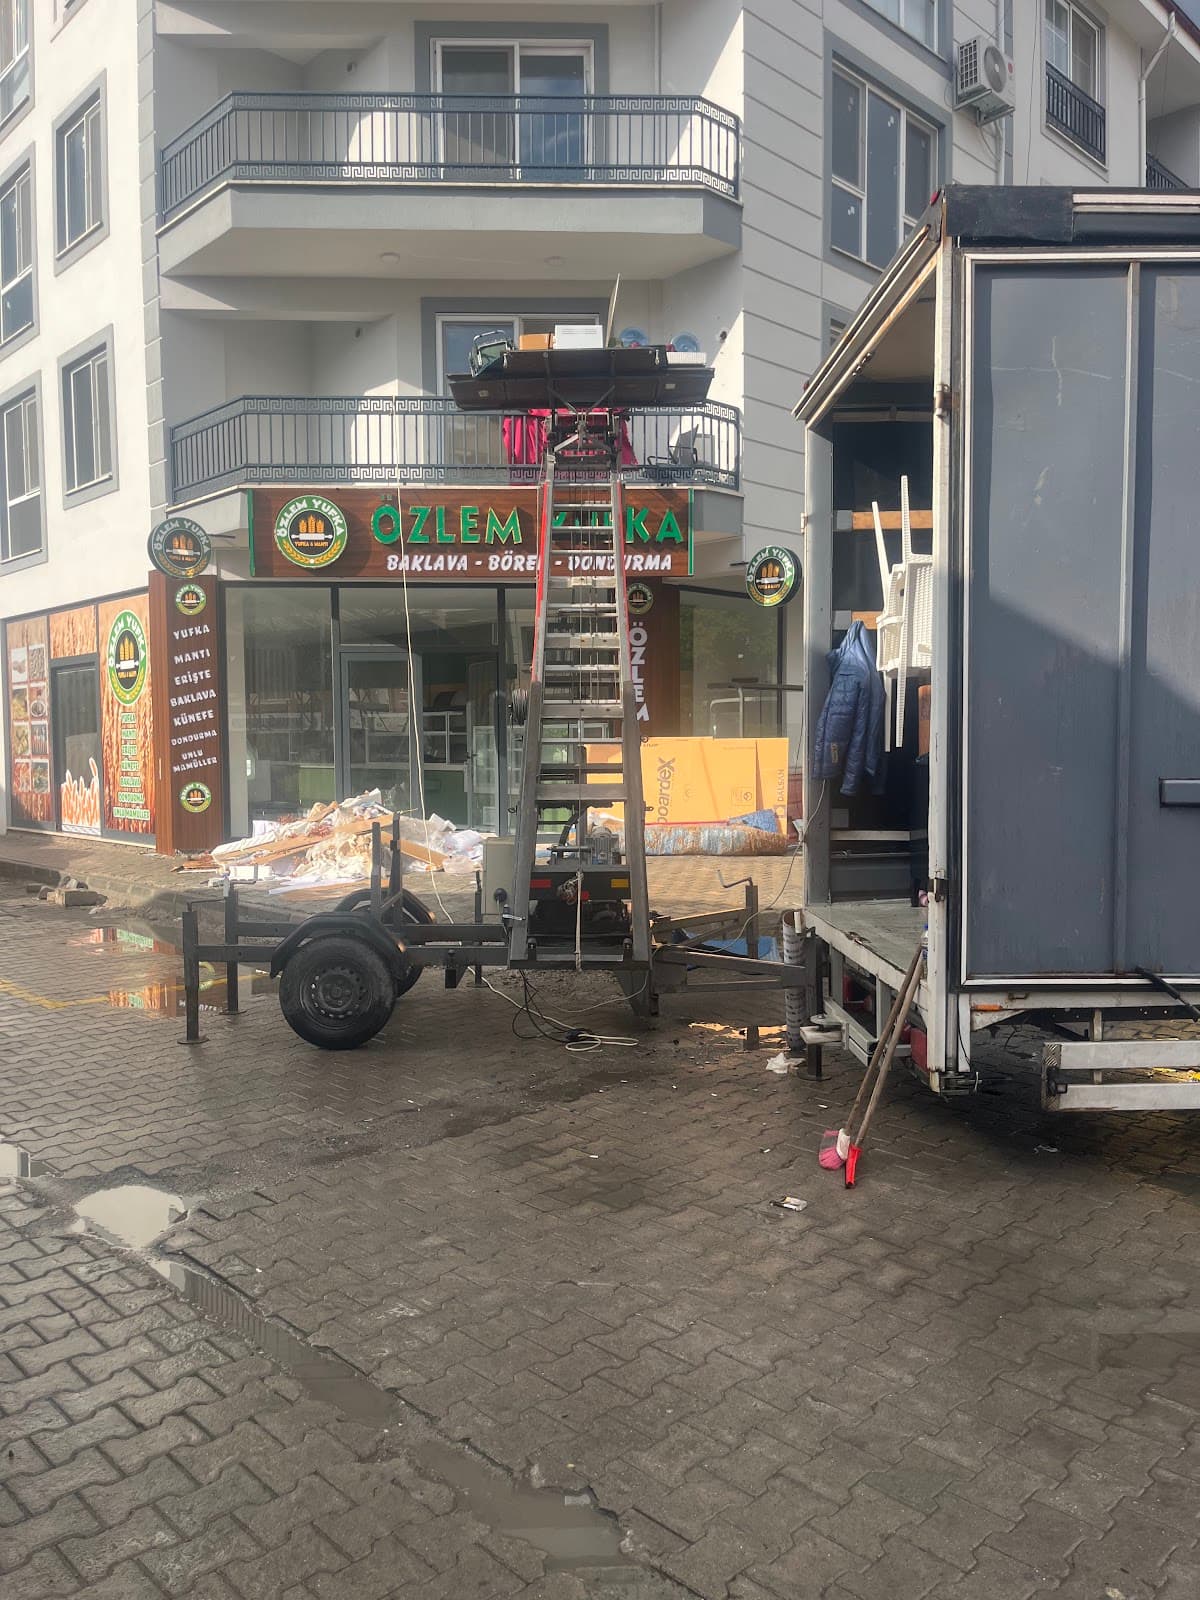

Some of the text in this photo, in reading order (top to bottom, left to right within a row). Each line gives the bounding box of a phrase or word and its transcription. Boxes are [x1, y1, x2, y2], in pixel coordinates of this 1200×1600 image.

[276, 499, 345, 537] ÖZLEM YUFKA
[371, 494, 522, 544] ÖZLEM
[184, 520, 211, 553] YUFKA
[386, 554, 468, 572] BAKLAVA
[488, 550, 540, 572] BÖRE
[126, 615, 146, 660] YUFKA
[173, 624, 210, 640] YUFKA
[174, 648, 211, 664] MANTI
[174, 669, 212, 686] ERİŞTE
[170, 688, 217, 707] BAKLAVA
[173, 709, 215, 727] KÜNEFE
[171, 729, 217, 746] DONDURMA
[182, 749, 204, 760] UNLU
[173, 756, 218, 773] MAMÜLLER
